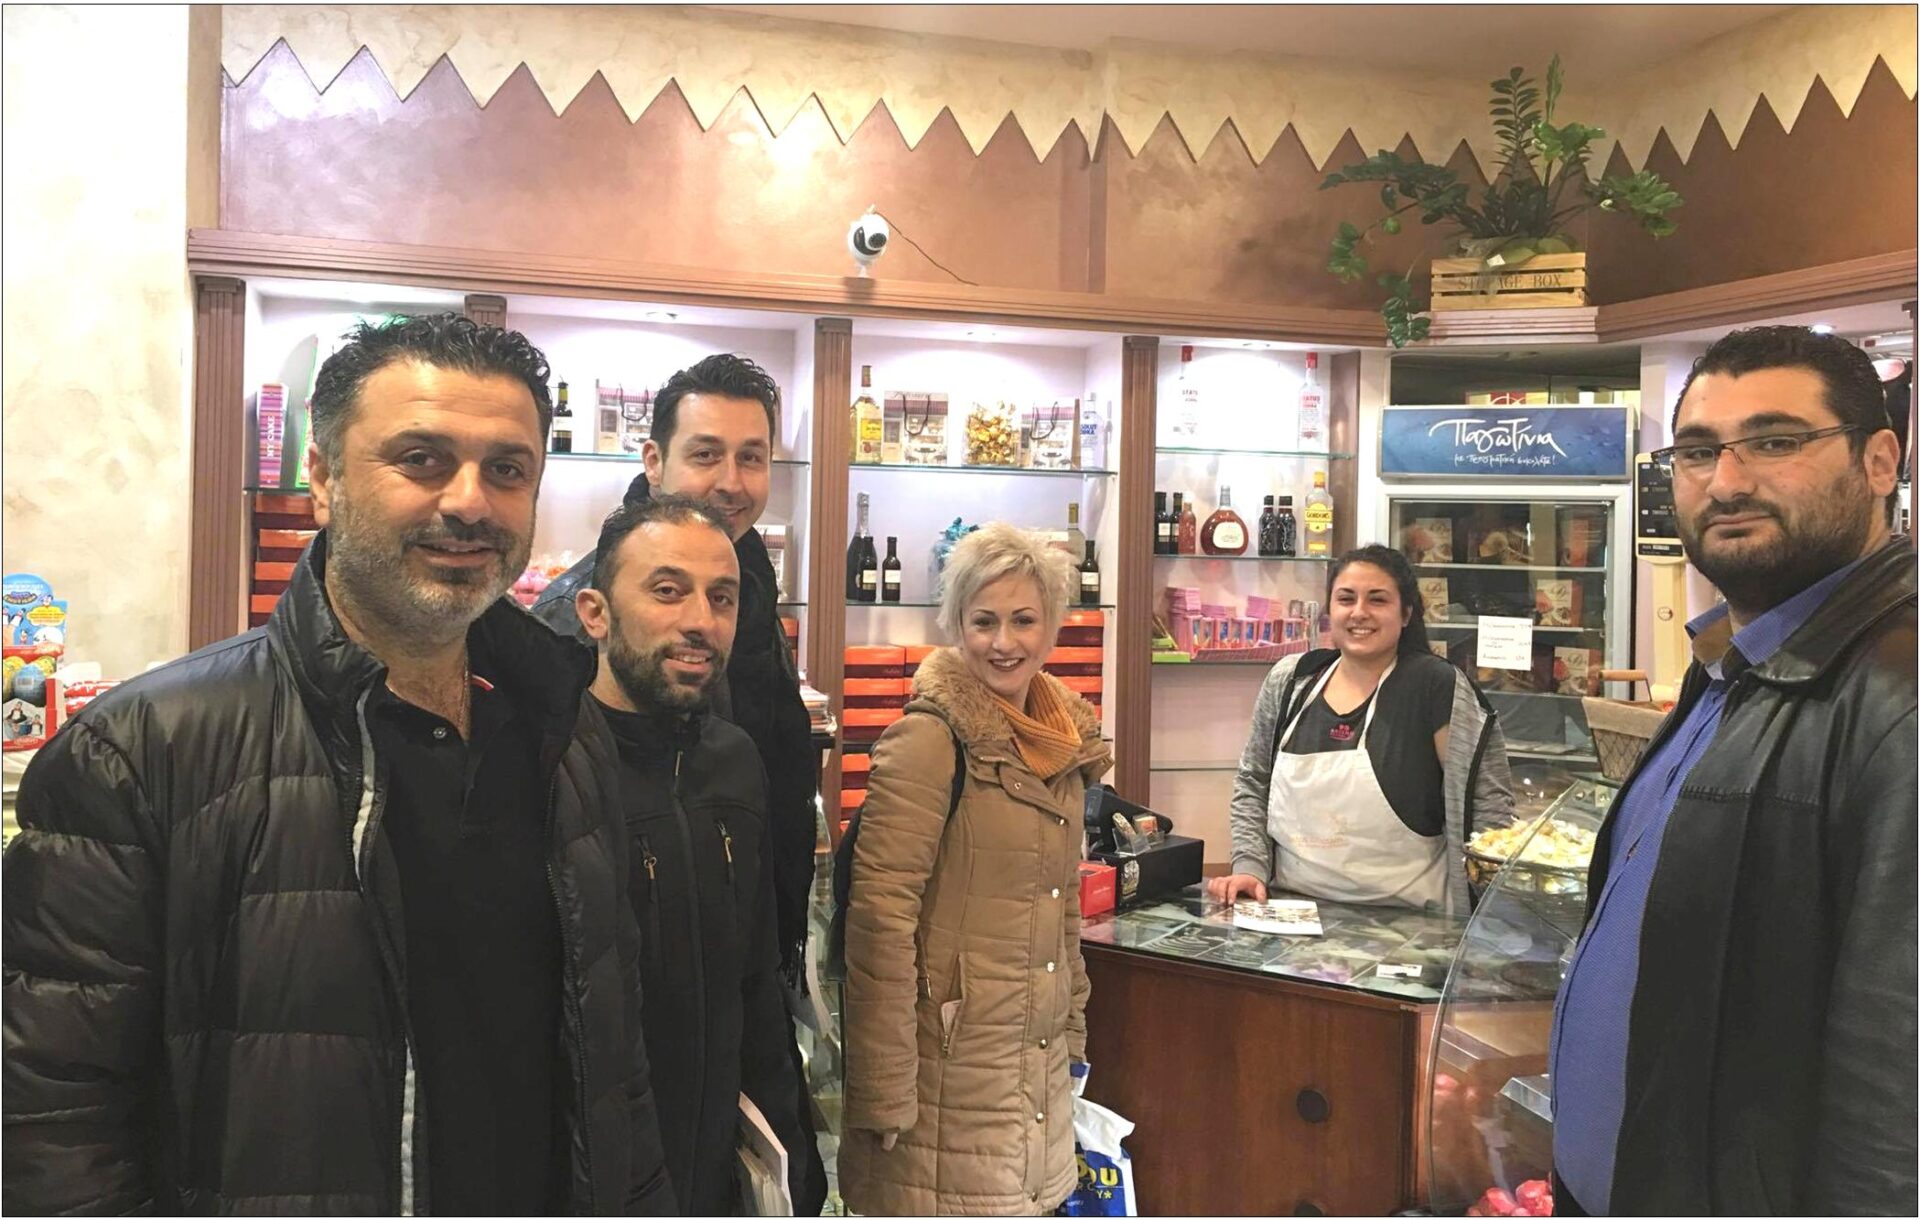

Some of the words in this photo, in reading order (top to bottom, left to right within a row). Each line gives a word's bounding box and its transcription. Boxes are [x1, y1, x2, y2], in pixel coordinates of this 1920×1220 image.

[1533, 273, 1562, 288] BOX
[267, 416, 275, 441] CAKE
[267, 443, 275, 457] MY
